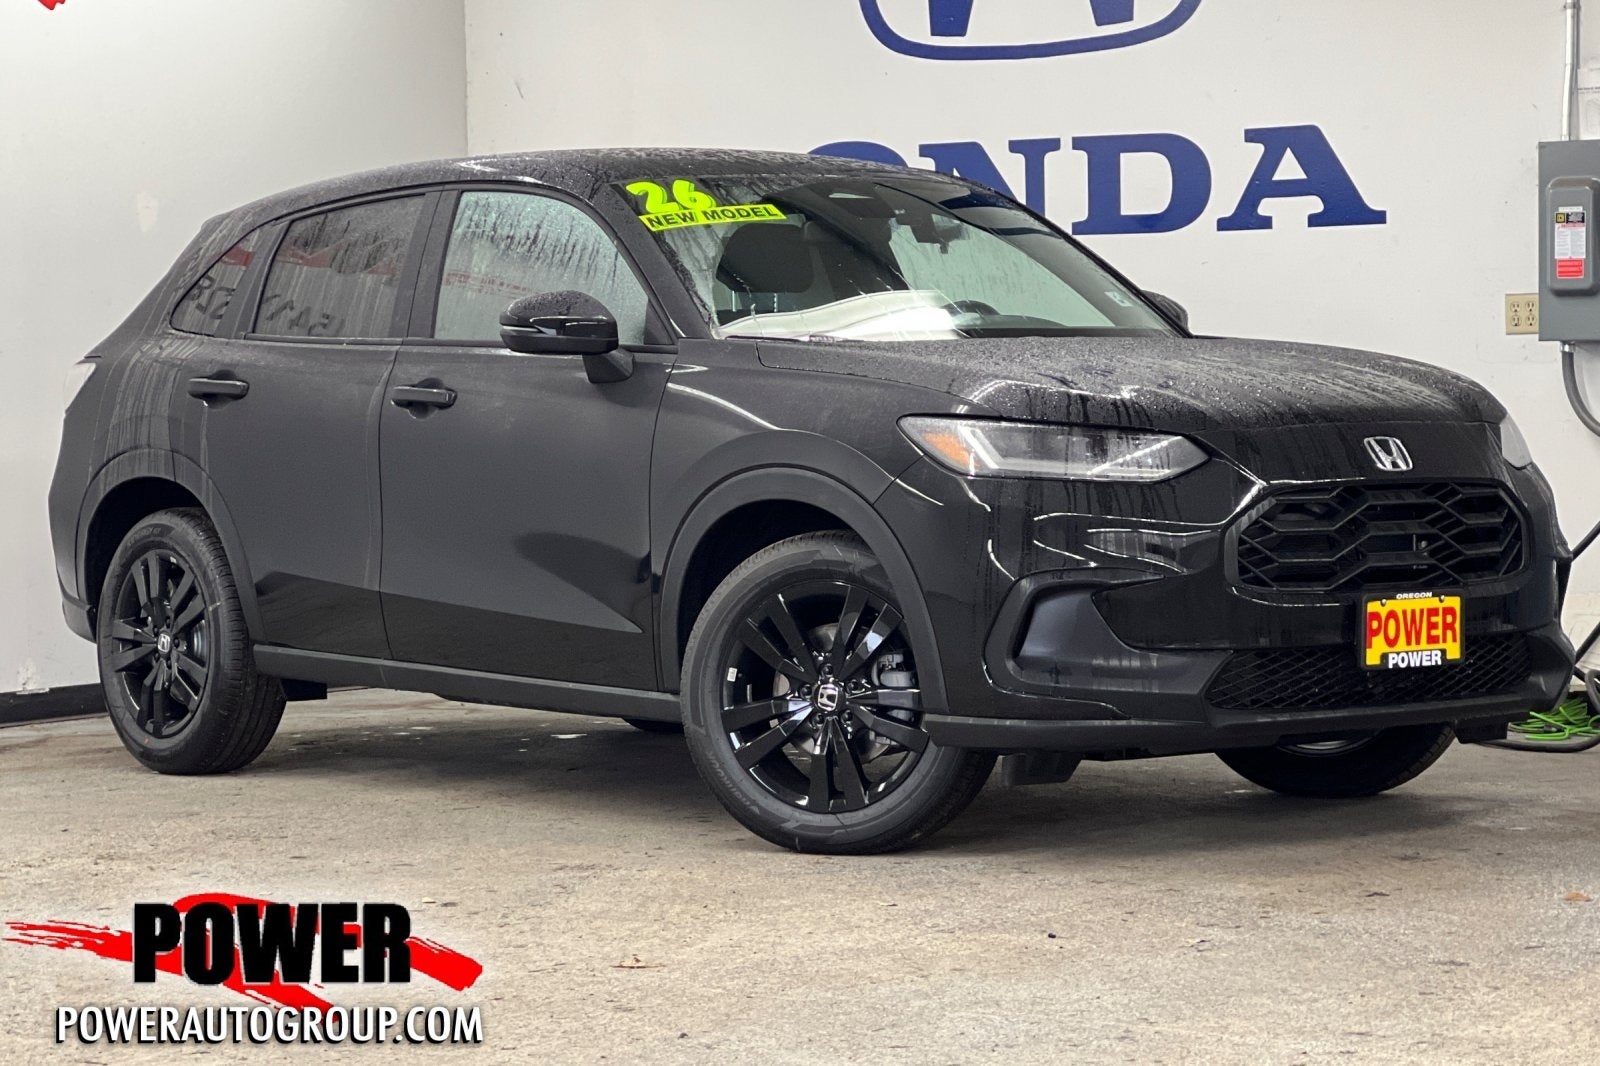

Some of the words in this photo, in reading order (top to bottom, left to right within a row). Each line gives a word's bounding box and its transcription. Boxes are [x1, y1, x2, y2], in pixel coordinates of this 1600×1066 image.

[807, 124, 1387, 235] NDA
[626, 179, 716, 214] 26
[646, 211, 695, 228] NEW
[703, 205, 778, 221] MODEL
[1396, 591, 1433, 600] OREGON
[1366, 606, 1458, 649] POWER
[1388, 650, 1442, 669] POWER
